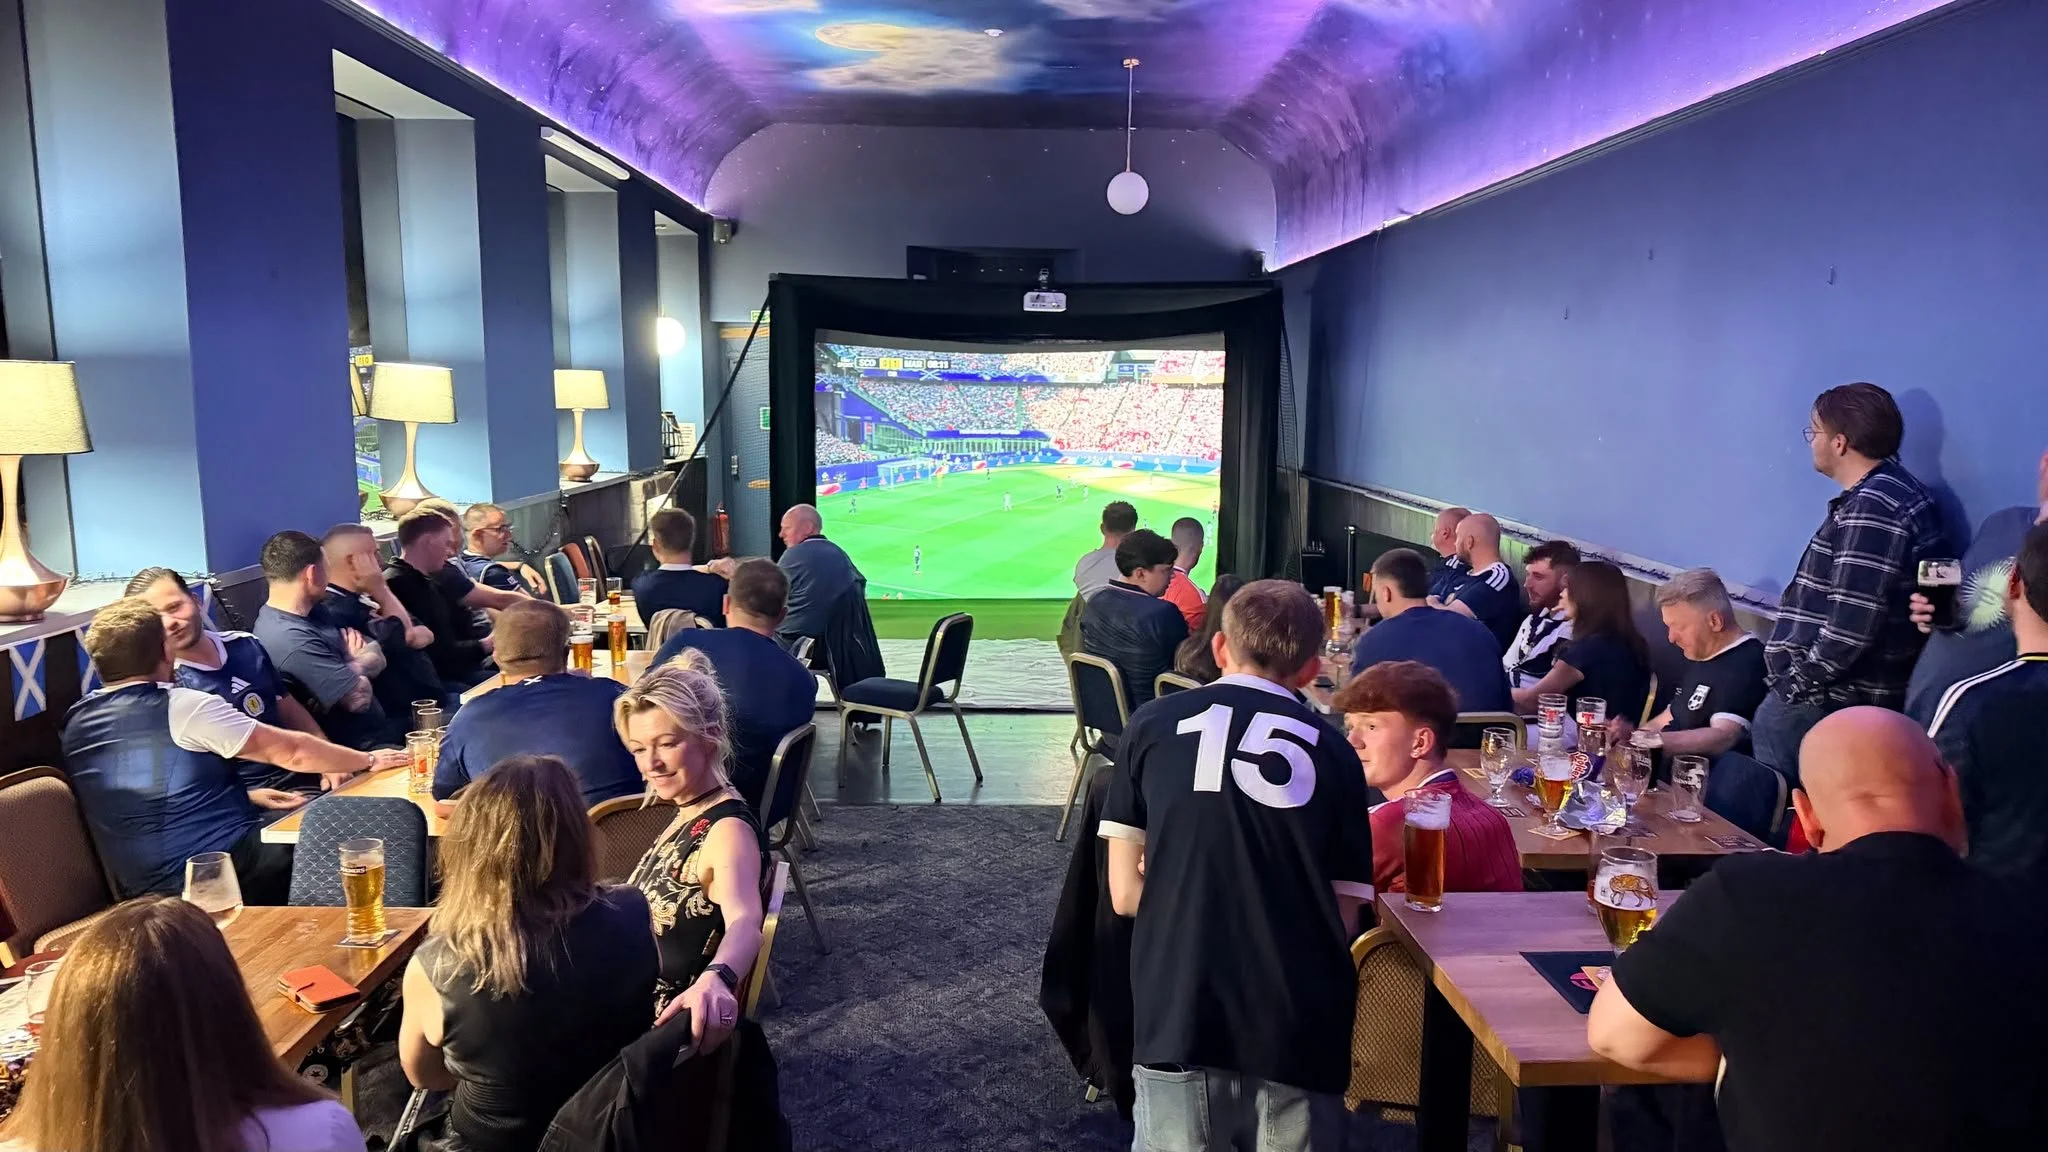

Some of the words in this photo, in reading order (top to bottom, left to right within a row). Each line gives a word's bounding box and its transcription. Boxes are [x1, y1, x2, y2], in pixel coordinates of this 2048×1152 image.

[858, 359, 876, 367] SCO
[904, 360, 923, 368] MAR
[1582, 713, 1595, 727] T
[1177, 703, 1320, 808] 15
